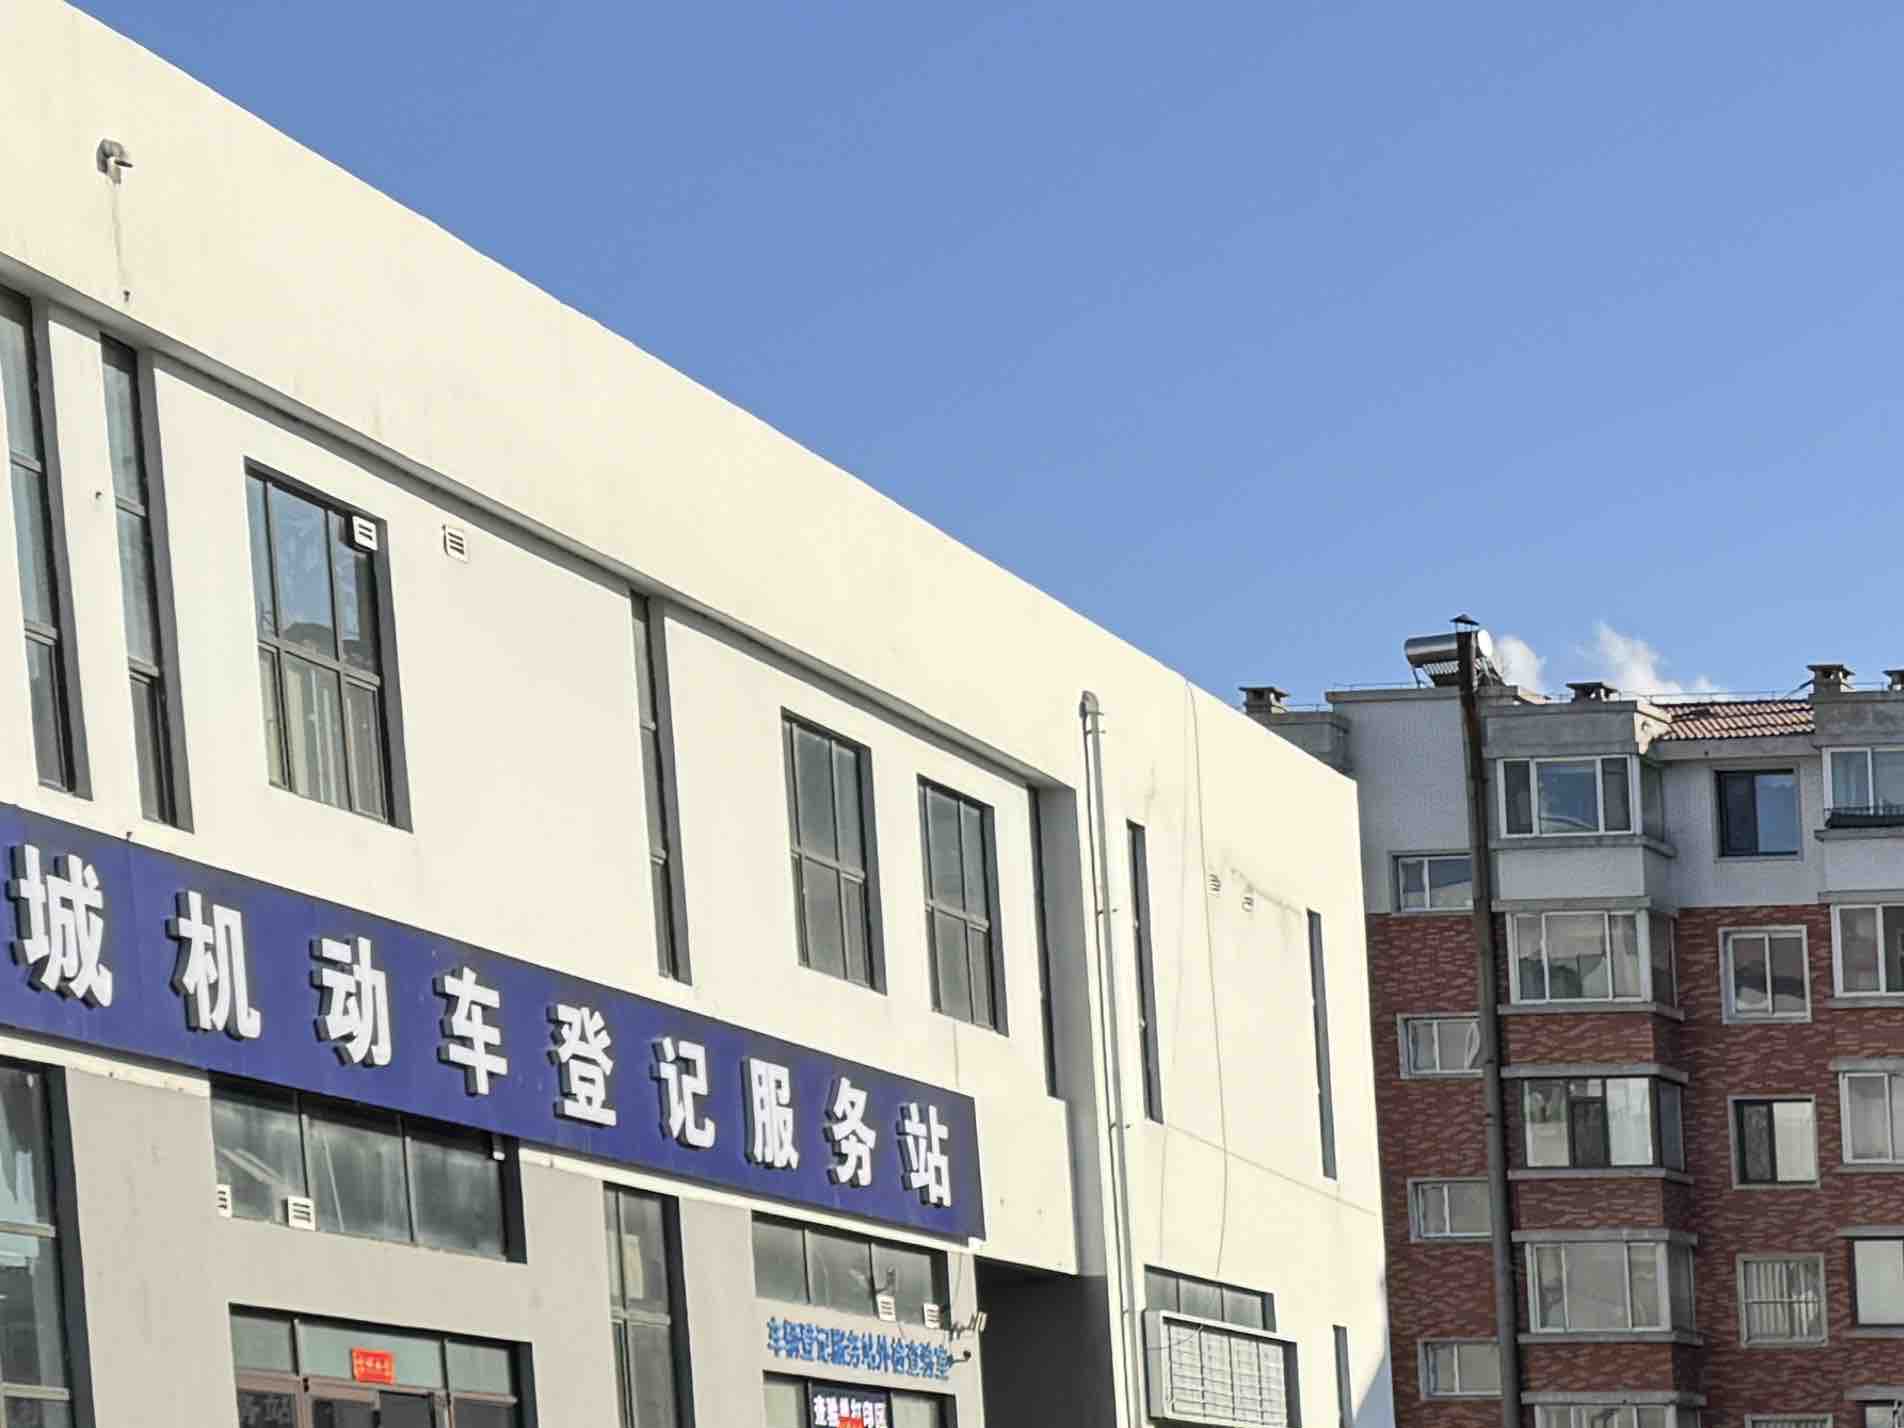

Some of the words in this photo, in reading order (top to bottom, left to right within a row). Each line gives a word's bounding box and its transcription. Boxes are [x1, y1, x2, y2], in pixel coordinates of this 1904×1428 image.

[13, 843, 954, 1208] 城机动车登记服务站
